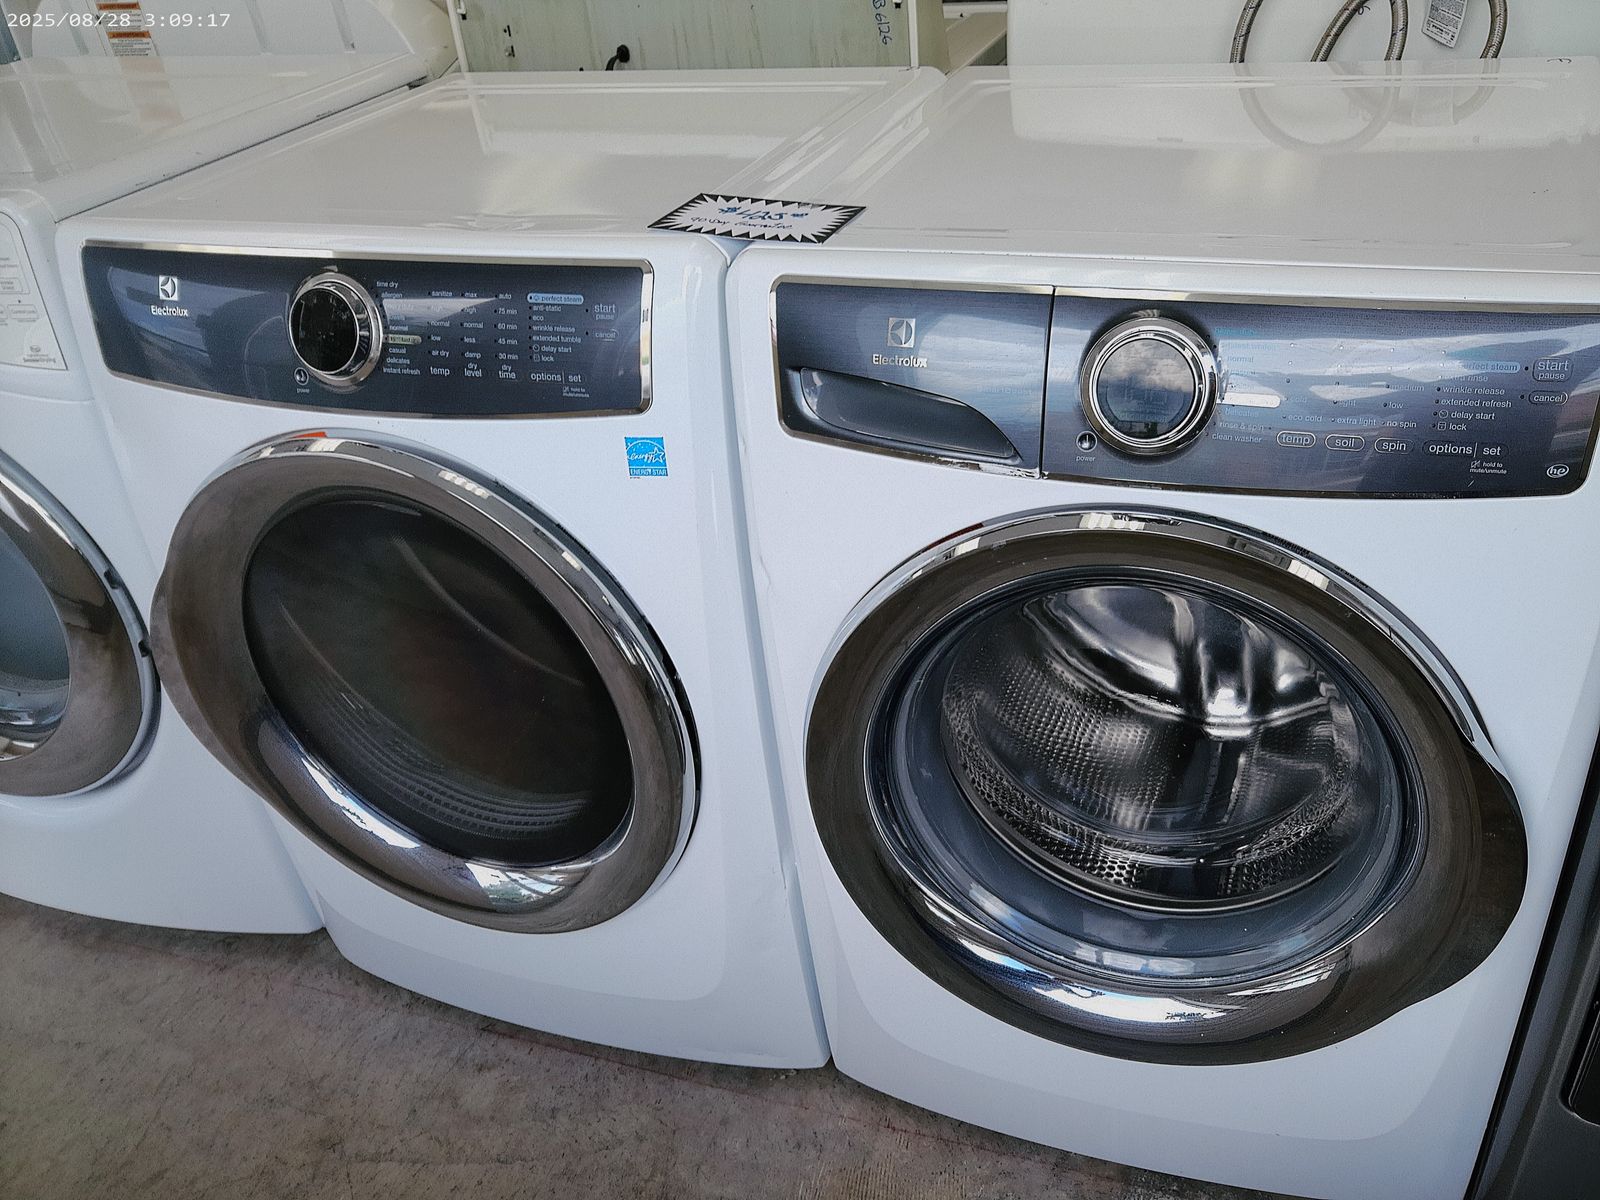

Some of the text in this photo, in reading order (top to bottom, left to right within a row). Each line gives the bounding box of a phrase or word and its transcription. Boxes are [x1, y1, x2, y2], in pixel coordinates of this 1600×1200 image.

[389, 281, 399, 289] dry
[150, 304, 189, 317] Electrolux
[498, 307, 506, 315] 75
[532, 304, 562, 312] anti-static
[594, 303, 617, 313] start
[595, 313, 615, 321] pause
[430, 319, 450, 327] normal
[463, 321, 484, 329] normal
[497, 322, 518, 330] 60 min
[532, 324, 576, 333] wrinkle release
[595, 330, 616, 339] cancel
[497, 337, 518, 345] 45 min
[560, 335, 582, 344] tumble
[388, 346, 407, 354] casual
[541, 345, 557, 353] delay
[439, 350, 450, 358] dry
[464, 351, 482, 360] damp
[541, 354, 555, 362] lock
[386, 356, 411, 365] delicates
[872, 353, 928, 368] Electrolux
[1537, 359, 1570, 371] start
[467, 362, 478, 370] dry
[501, 364, 512, 372] dry
[1490, 362, 1518, 371] steam
[429, 366, 450, 377] temp
[464, 367, 482, 378] level
[498, 370, 516, 379] time
[1537, 371, 1566, 381] pause
[530, 372, 562, 383] options
[568, 373, 582, 383] set
[1467, 374, 1489, 382] rinse
[1442, 385, 1505, 396] wrinkle release
[1533, 392, 1564, 403] cancel
[1388, 400, 1404, 409] low
[1440, 397, 1512, 409] extended refresh
[1287, 414, 1323, 422] eco cold
[1450, 410, 1496, 421] delay start
[1219, 421, 1239, 429] rinse
[1336, 415, 1377, 428] extra light
[1385, 419, 1417, 429] no spin
[1449, 422, 1468, 431] lock
[1211, 432, 1263, 443] clean washer
[1281, 434, 1311, 446] temp
[1335, 437, 1356, 448] soil
[1381, 440, 1407, 452] spin
[1428, 443, 1473, 455] options
[1482, 446, 1501, 456] set
[1075, 455, 1096, 463] power
[1469, 467, 1508, 475] mute/unmute
[1547, 464, 1569, 478] he
